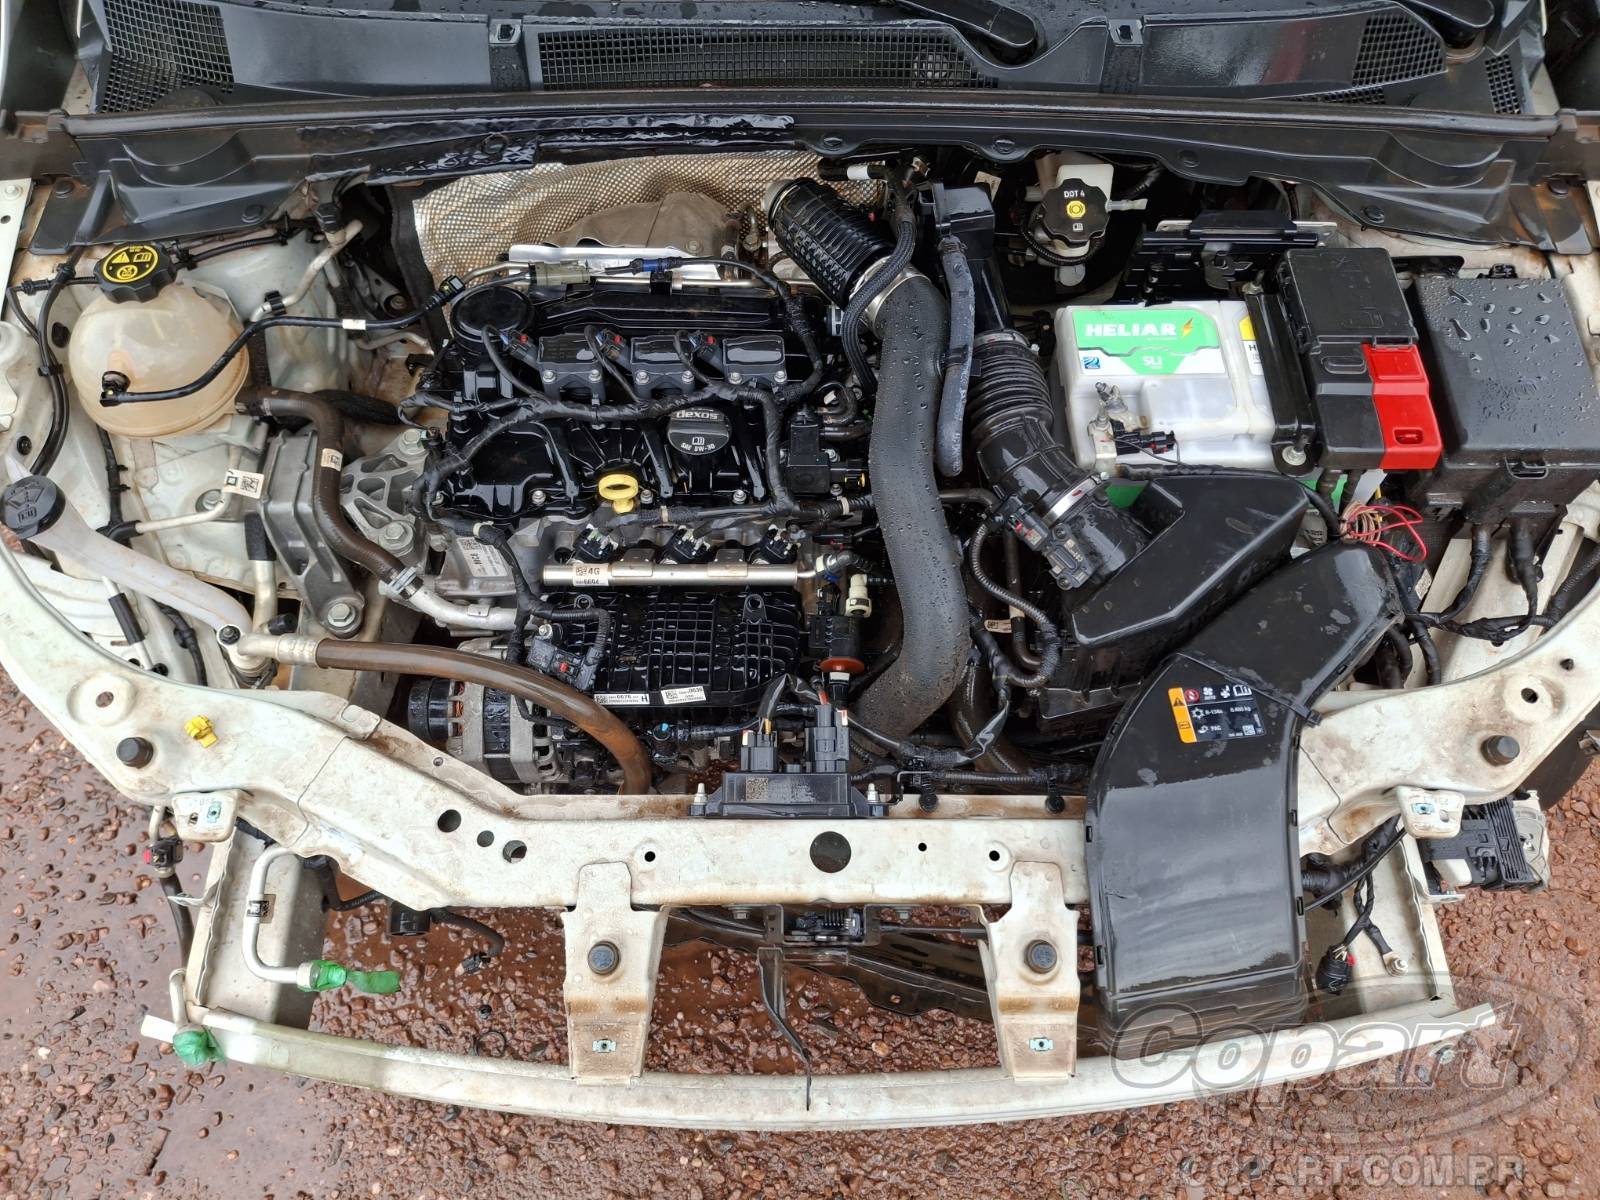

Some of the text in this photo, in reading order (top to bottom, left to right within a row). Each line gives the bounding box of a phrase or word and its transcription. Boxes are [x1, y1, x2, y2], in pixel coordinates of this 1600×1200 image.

[1063, 190, 1078, 198] DOT
[1085, 323, 1177, 337] HELIAR
[676, 410, 720, 420] dexos
[587, 567, 600, 575] 4G
